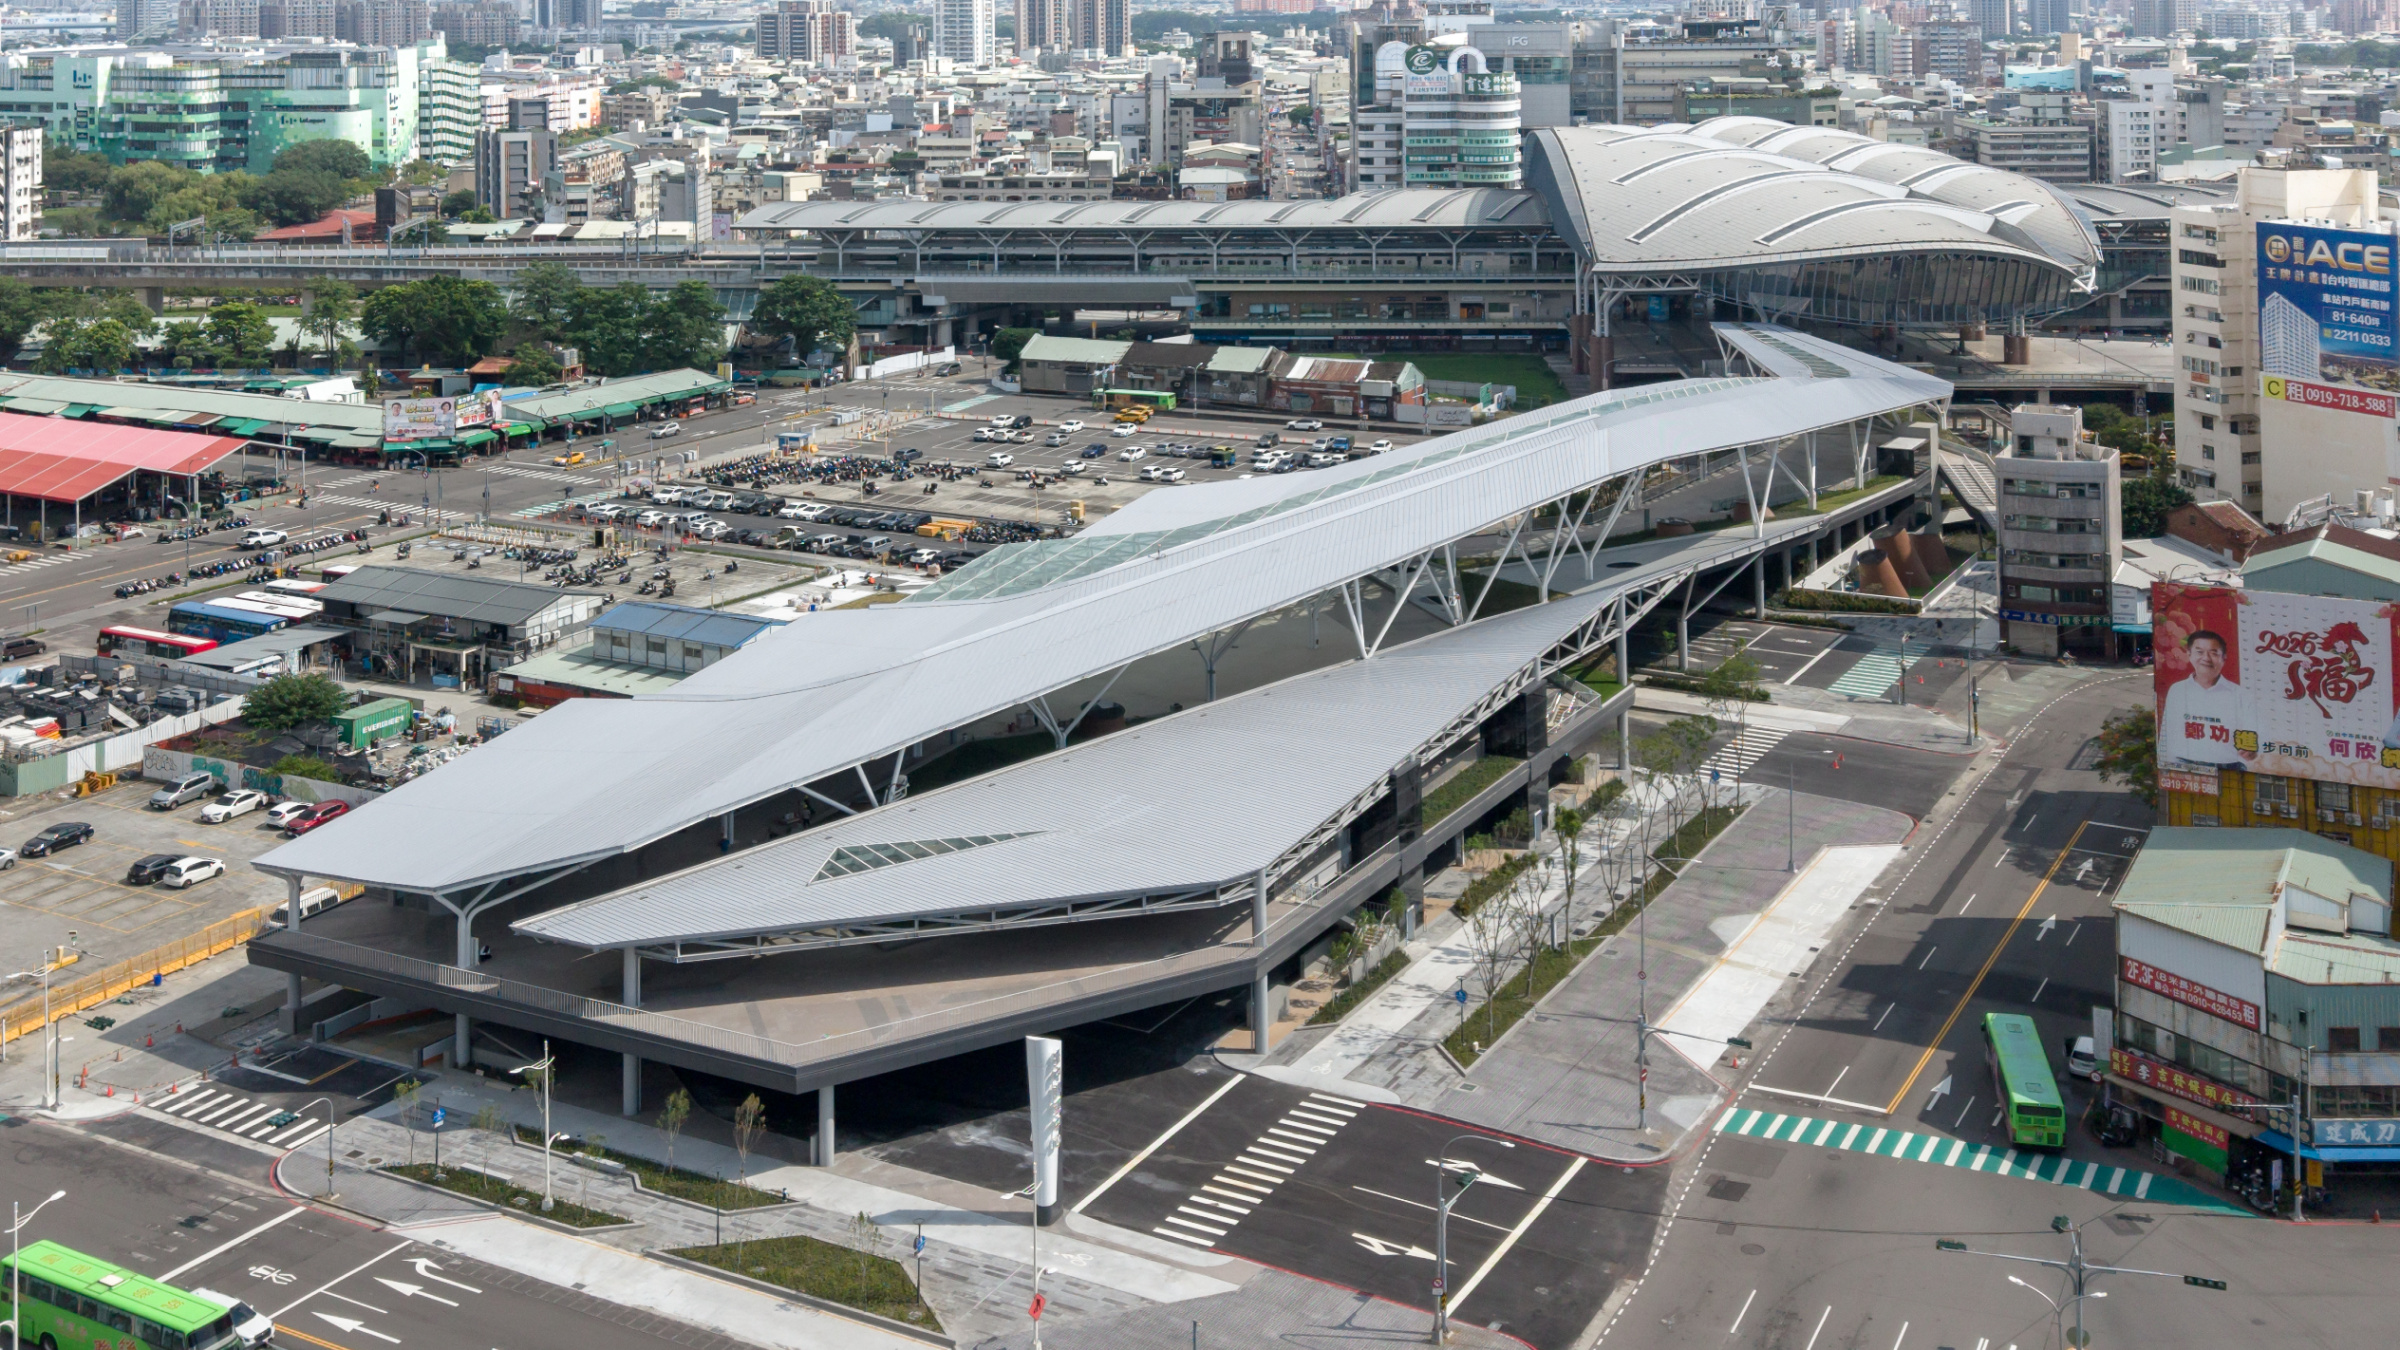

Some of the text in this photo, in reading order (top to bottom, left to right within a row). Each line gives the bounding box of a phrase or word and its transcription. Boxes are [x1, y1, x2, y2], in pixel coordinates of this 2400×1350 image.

[1465, 76, 1493, 93] 育達
[2305, 239, 2391, 275] ACE
[2333, 328, 2360, 342] 2211
[2361, 332, 2392, 347] 0333
[2267, 380, 2281, 396] C
[2286, 382, 2306, 402] 租
[2306, 388, 2387, 412] 0919-718-588
[2254, 630, 2317, 658] 2026
[2187, 993, 2243, 1022] 0910-426453
[2242, 1004, 2256, 1025] 租
[2325, 1121, 2400, 1143] 建成刀
